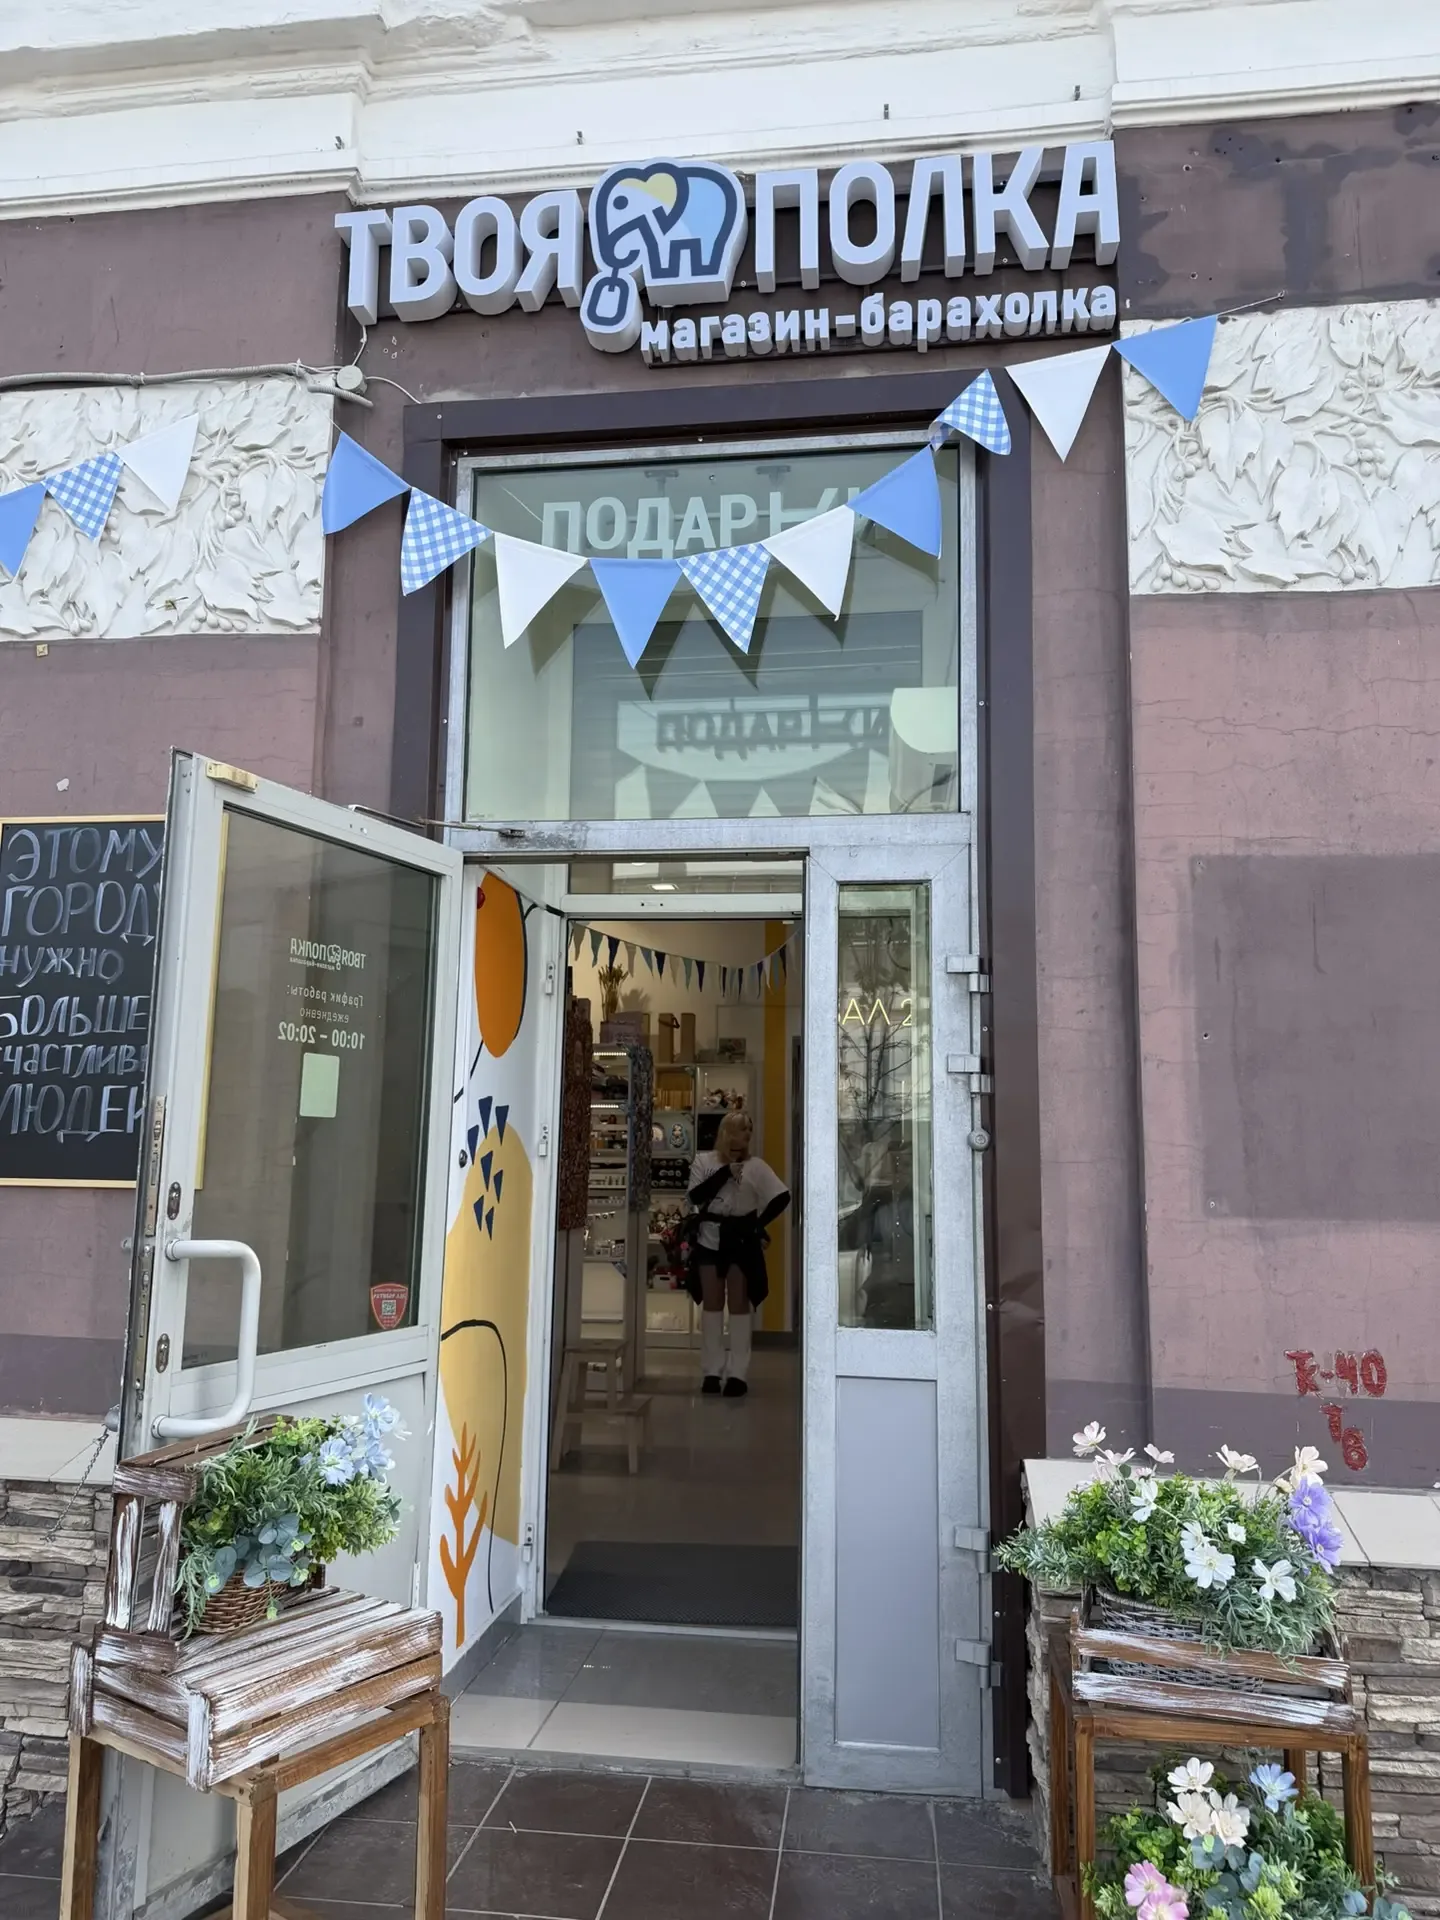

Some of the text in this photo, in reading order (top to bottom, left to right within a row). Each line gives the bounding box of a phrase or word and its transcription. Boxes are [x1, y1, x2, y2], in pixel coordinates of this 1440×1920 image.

[334, 140, 1121, 322] ТВОЯ ПОЛКА
[640, 285, 1116, 358] магазин-барахолка
[541, 487, 886, 559] ПОДАРК
[7, 828, 165, 882] ЭТОМУ
[2, 881, 161, 947] ГОРОД
[838, 998, 891, 1026] АЛ
